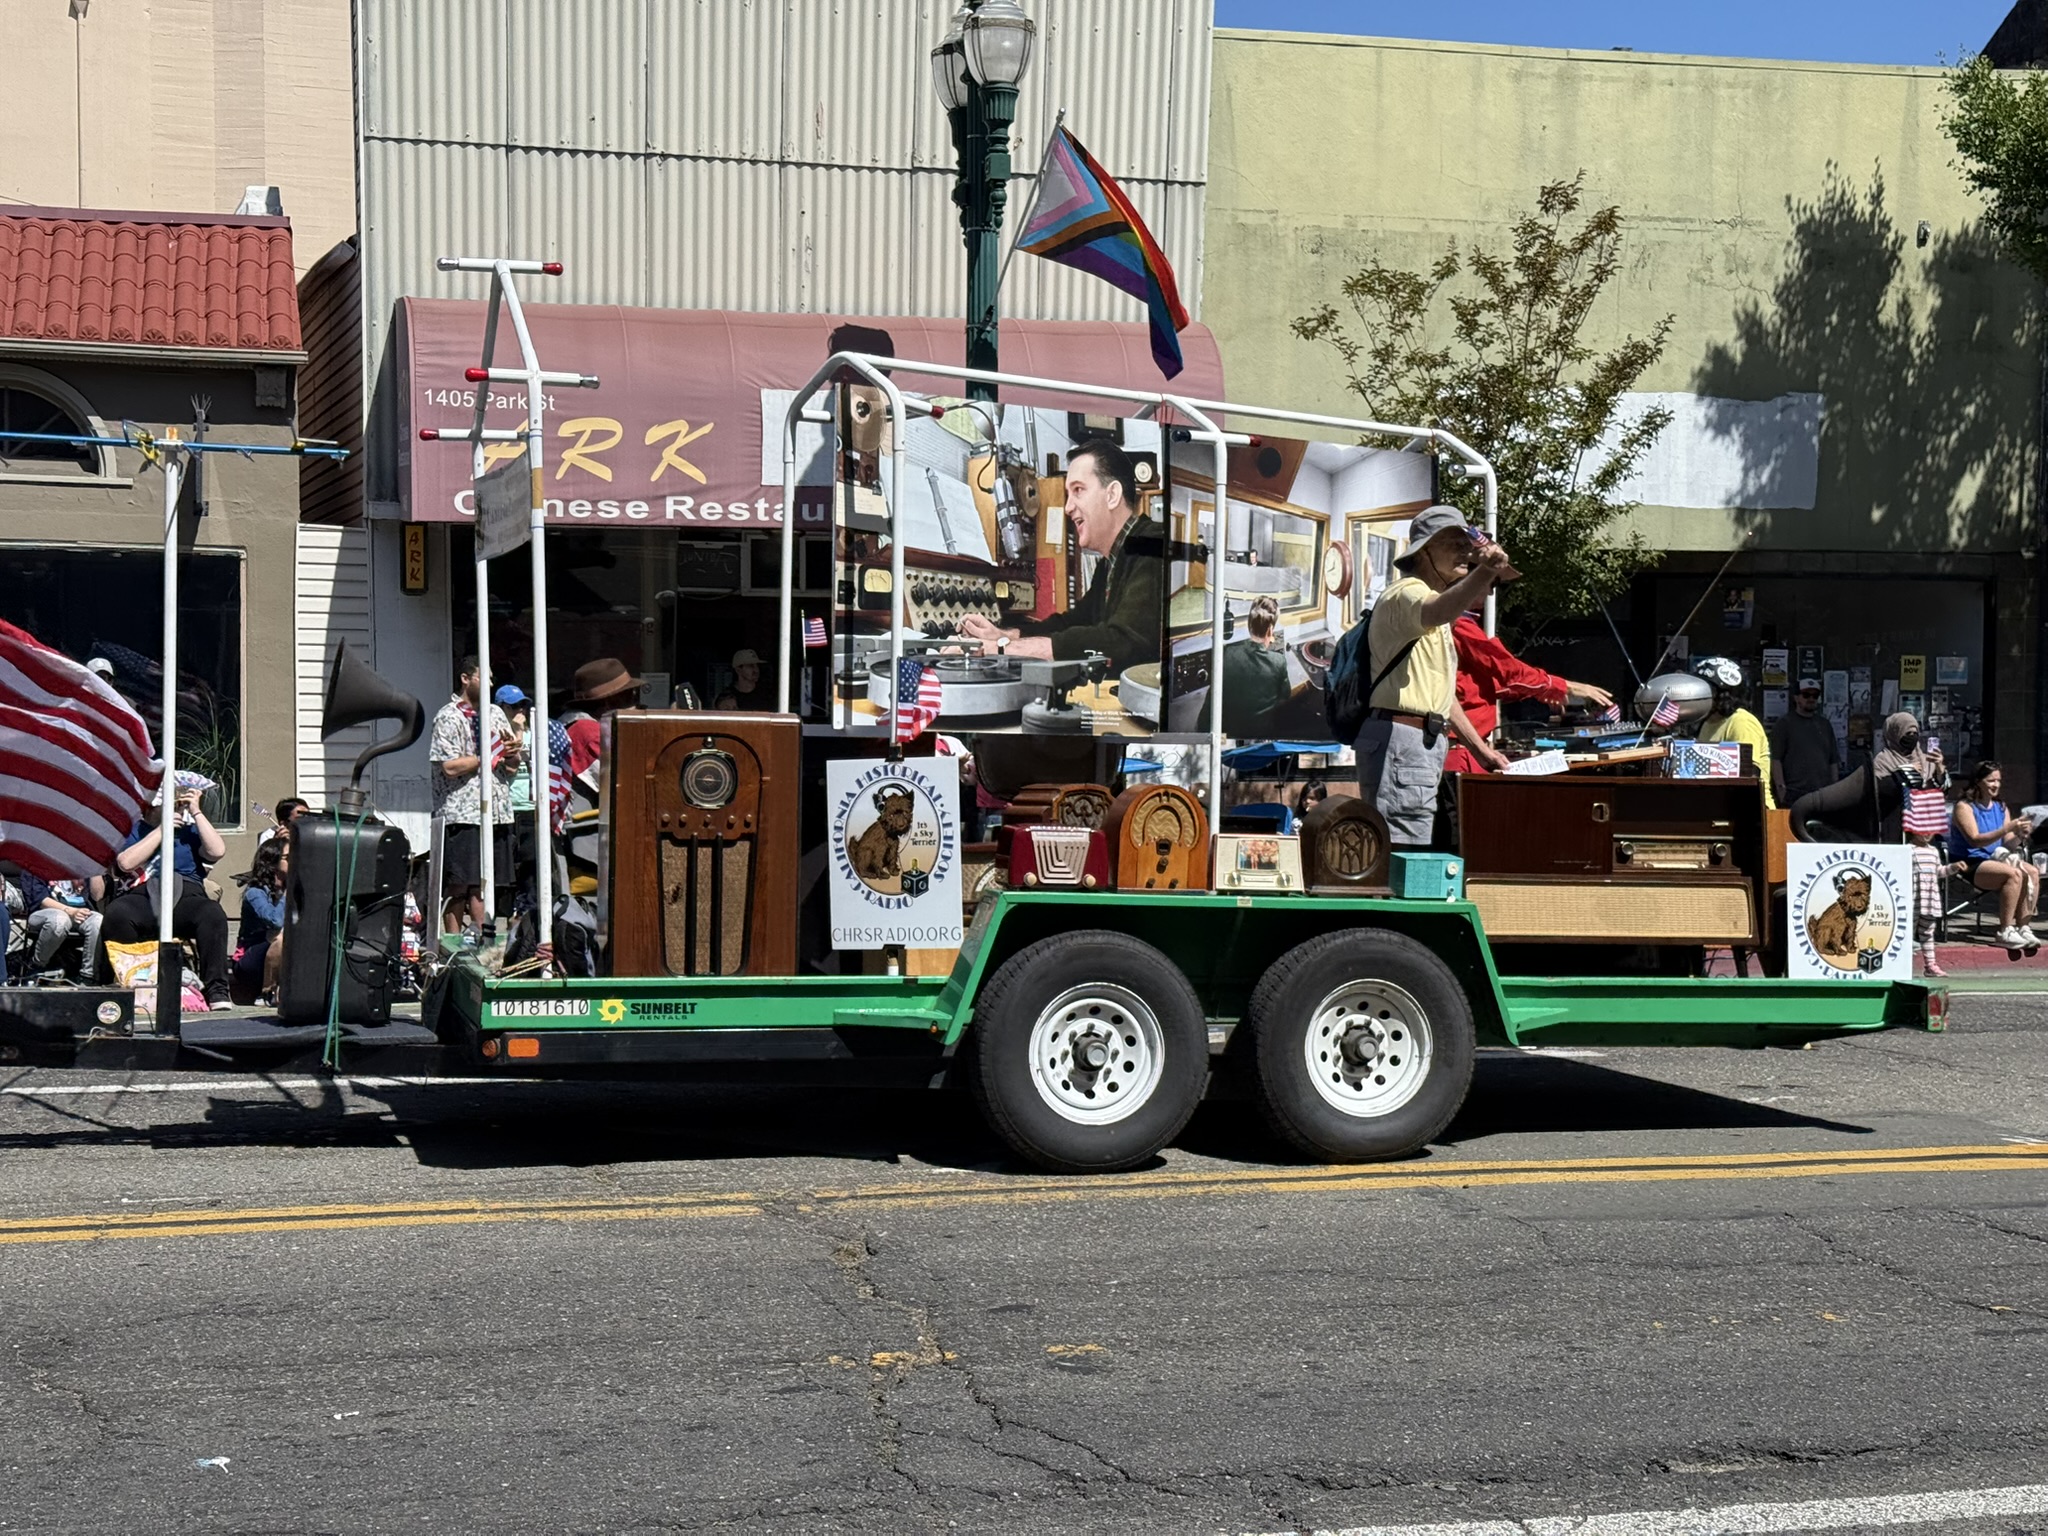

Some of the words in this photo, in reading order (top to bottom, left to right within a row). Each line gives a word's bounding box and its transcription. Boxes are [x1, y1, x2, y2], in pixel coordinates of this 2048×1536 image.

[424, 388, 475, 407] 1405
[484, 392, 529, 411] Park
[453, 489, 650, 520] Cnese
[409, 531, 422, 582] ARK
[1903, 659, 1922, 667] IMP
[1698, 745, 1709, 755] NO
[1709, 749, 1730, 766] KINGS
[832, 790, 863, 891] CALIFORNIA
[855, 764, 945, 809] HISTORICAL
[920, 830, 934, 838] Sky
[910, 837, 937, 846] Terrier
[864, 891, 914, 910] RADIO
[933, 808, 954, 883] SOCIETY
[1792, 872, 1819, 967] CALIFORNIA
[1815, 849, 1898, 887] HISTORICAL
[1876, 912, 1889, 920] Sky
[1868, 919, 1891, 927] Terrier
[1887, 895, 1907, 961] SOCIETY
[832, 926, 962, 942] CHRSRADIO.ORG
[493, 1000, 590, 1016] 10181610
[630, 1002, 698, 1015] SUNBELT
